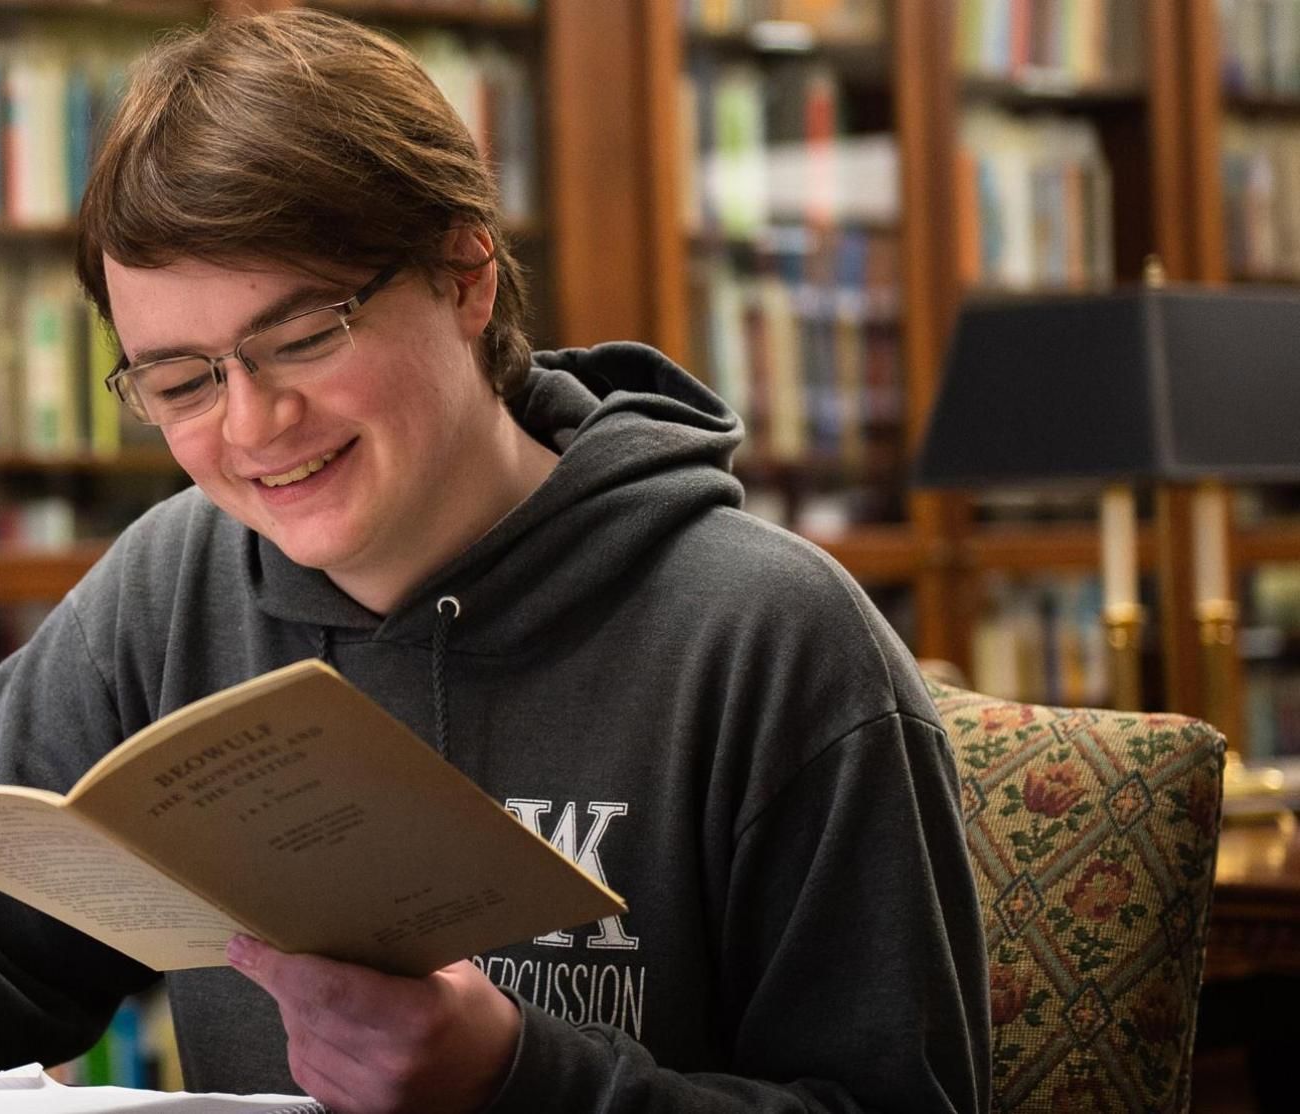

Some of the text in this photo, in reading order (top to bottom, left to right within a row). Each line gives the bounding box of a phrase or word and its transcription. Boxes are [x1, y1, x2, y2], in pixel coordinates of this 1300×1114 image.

[154, 722, 271, 788] BEOWULF
[148, 792, 186, 818] THE
[472, 955, 645, 1041] CUSSION
